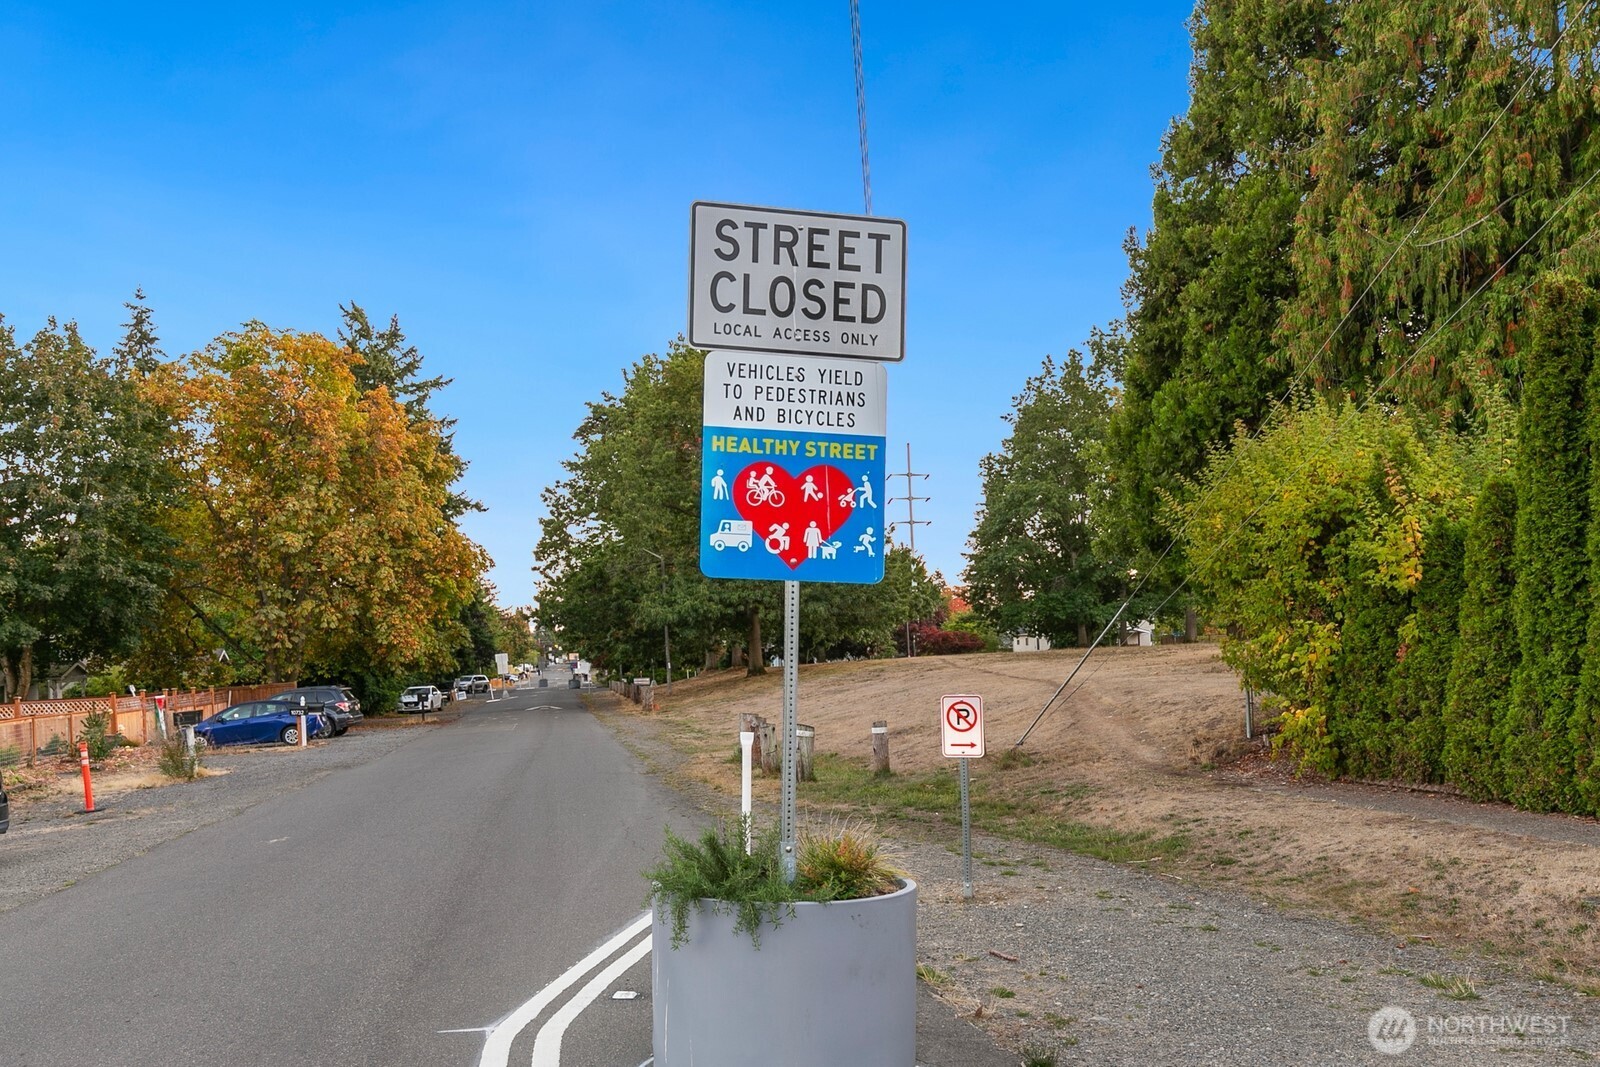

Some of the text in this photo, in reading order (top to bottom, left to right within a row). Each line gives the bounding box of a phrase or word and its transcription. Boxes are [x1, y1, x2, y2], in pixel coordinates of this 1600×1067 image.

[714, 218, 891, 274] STREET
[709, 270, 887, 325] CLOSED
[713, 322, 879, 347] LOCAL ACCESS ONLY
[726, 361, 864, 386] VEHICLES YIELD
[722, 383, 866, 408] TO PEDESTRIANS
[732, 405, 856, 428] AND BICYCLES
[711, 434, 878, 461] HEALTHY STREET
